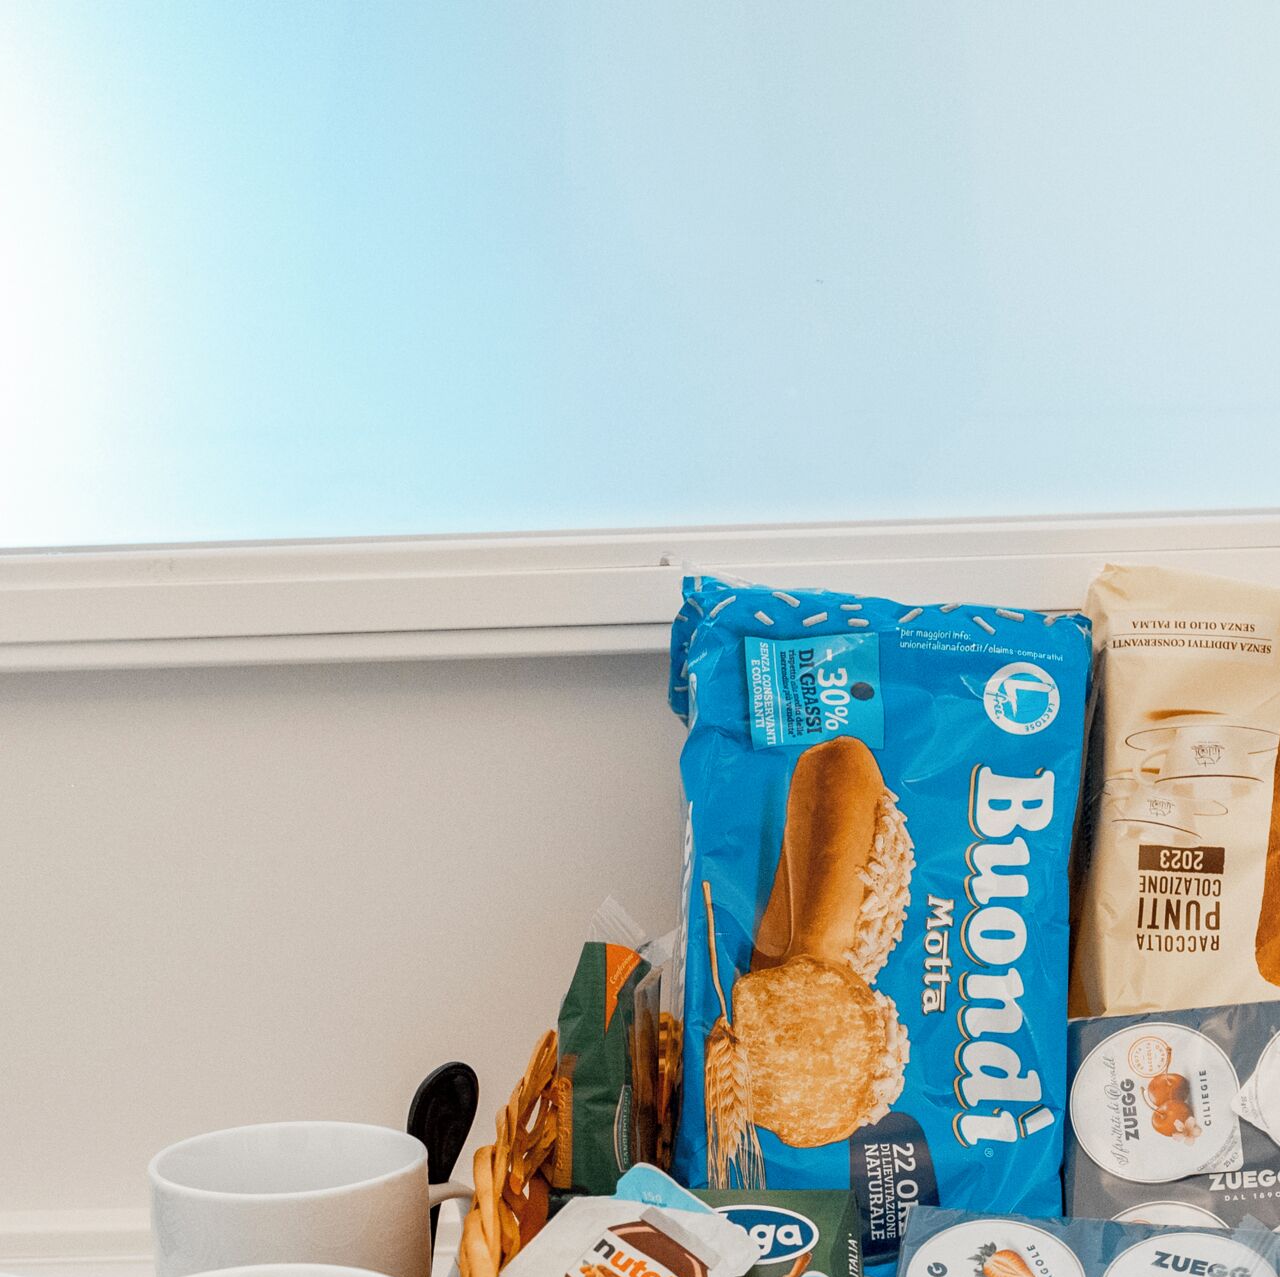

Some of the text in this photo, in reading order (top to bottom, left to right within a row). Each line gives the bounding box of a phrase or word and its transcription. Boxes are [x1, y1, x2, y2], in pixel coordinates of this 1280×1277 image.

[1112, 639, 1272, 654] SENZA ADDITIVI CONSERVANTI
[1132, 620, 1256, 632] SENZA OLIO DI PALMA
[751, 667, 765, 728] COLORANTI
[759, 642, 776, 745] SENZA CONSERVANTI
[799, 648, 822, 734] DI GRASSI
[1160, 849, 1203, 870] 2023
[1139, 875, 1221, 897] COLAZIONE
[1137, 898, 1220, 931] PUNTI
[922, 894, 955, 1015] Motta
[1136, 933, 1220, 952] RACCOLTA
[1120, 1079, 1140, 1140] ZUEGG
[1199, 1070, 1212, 1127] CILIEGIE
[892, 1142, 916, 1173] 22
[864, 1143, 885, 1240] NATURALE
[880, 1143, 896, 1239] DI LIEVITAZIONE
[1224, 1194, 1247, 1202] DAL
